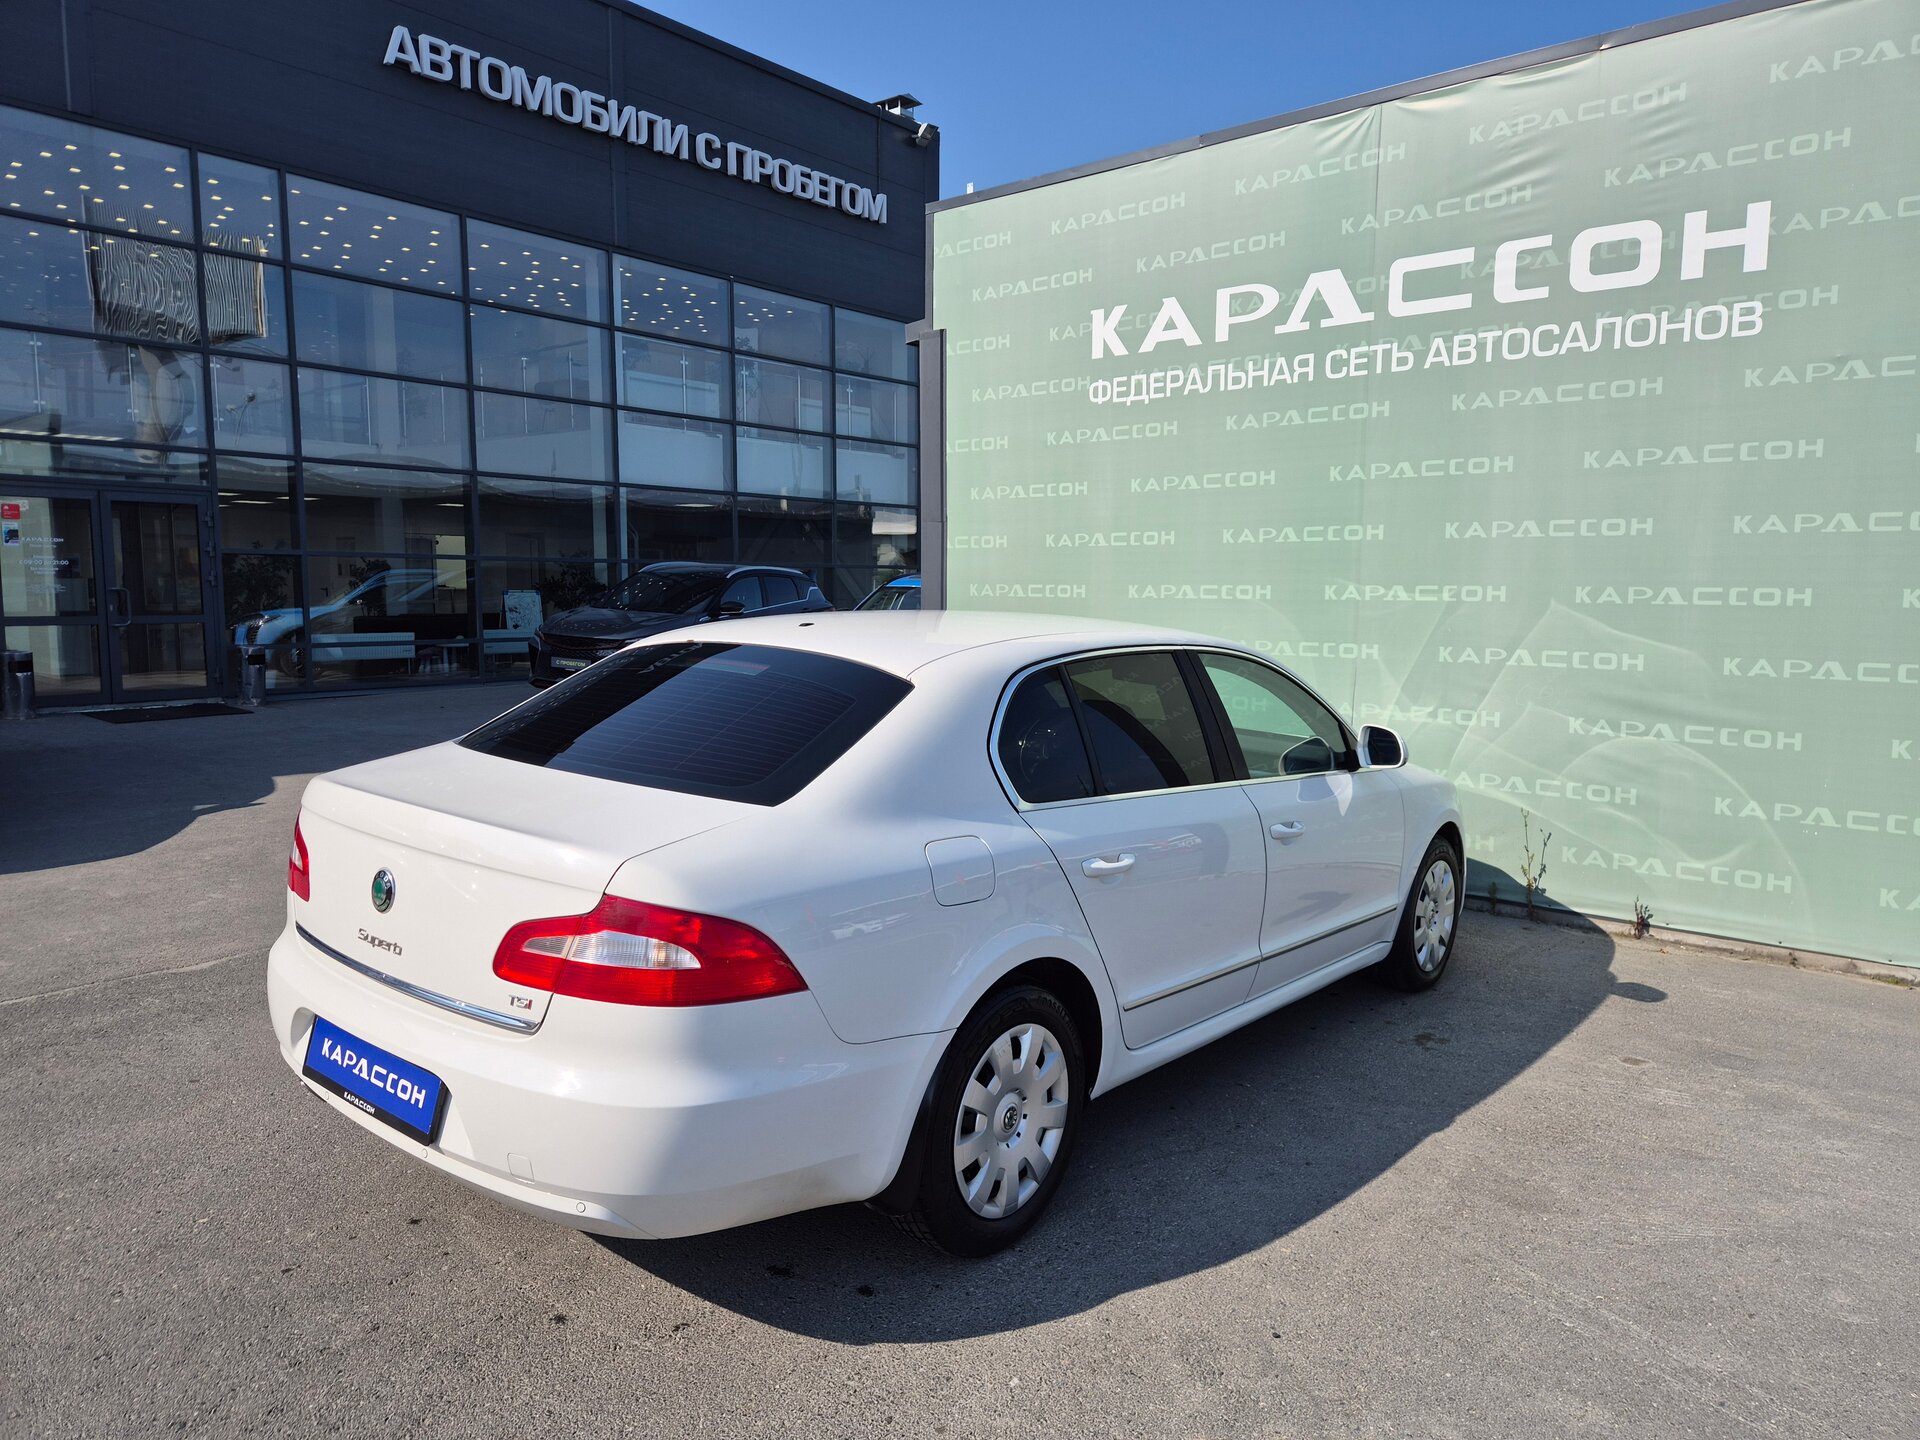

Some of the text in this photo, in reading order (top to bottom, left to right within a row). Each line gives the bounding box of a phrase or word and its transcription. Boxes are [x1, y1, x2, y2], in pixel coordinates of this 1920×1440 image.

[383, 25, 887, 224] АВТОМОБИЛИ С ПРОБЕГОМ
[1469, 82, 1687, 145] КАРАССОН
[1235, 142, 1406, 196] КАРАССОН
[1604, 127, 1852, 188] КАРАССОН
[1051, 191, 1186, 236] КАРАССОН
[1341, 184, 1533, 234] КАРАССОН
[1136, 230, 1286, 273] КАРАССОН
[973, 268, 1093, 302] КАРАССОН
[1091, 201, 1771, 359] КАРАССОН
[1089, 301, 1764, 406] ФЕДЕРАЛЬНАЯ СЕТЬ АВТОСАЛОНОВ
[1744, 354, 1918, 388] КАРАС
[972, 376, 1091, 402] КАРАССОН
[1452, 377, 1663, 411] КАРАССОН
[1226, 401, 1390, 431] КАРАССОН
[1047, 420, 1178, 446] КАРАССОН
[1584, 438, 1824, 469] КАРАССОН
[1131, 470, 1276, 493] КАРАССОН
[1329, 456, 1514, 481] КАРАССОН
[971, 481, 1088, 500] КАРАССОН
[1223, 525, 1384, 544] КАРАССОН
[1445, 518, 1653, 539] КАРАССОН
[1733, 512, 1920, 534] КАРАС
[1046, 530, 1175, 548] КАРАССОН
[970, 583, 1086, 599] КАРАССОН
[1129, 585, 1271, 600] КАРАССОН
[1325, 584, 1506, 602] КАРАССОН
[1576, 587, 1812, 608] КАРАССОН
[1439, 647, 1645, 671] КАРАССОН
[1724, 657, 1920, 684] КАРАСС
[1337, 703, 1500, 728] АРАССОН
[1568, 716, 1802, 751] КАРАССОН
[1715, 797, 1920, 837] КАРАСС
[1562, 846, 1792, 894] КАРАССОН
[358, 928, 403, 956] Superb
[509, 994, 532, 1010] TSI
[321, 1037, 427, 1109] КАРАССОН
[343, 1091, 376, 1115] КАРАССОН
